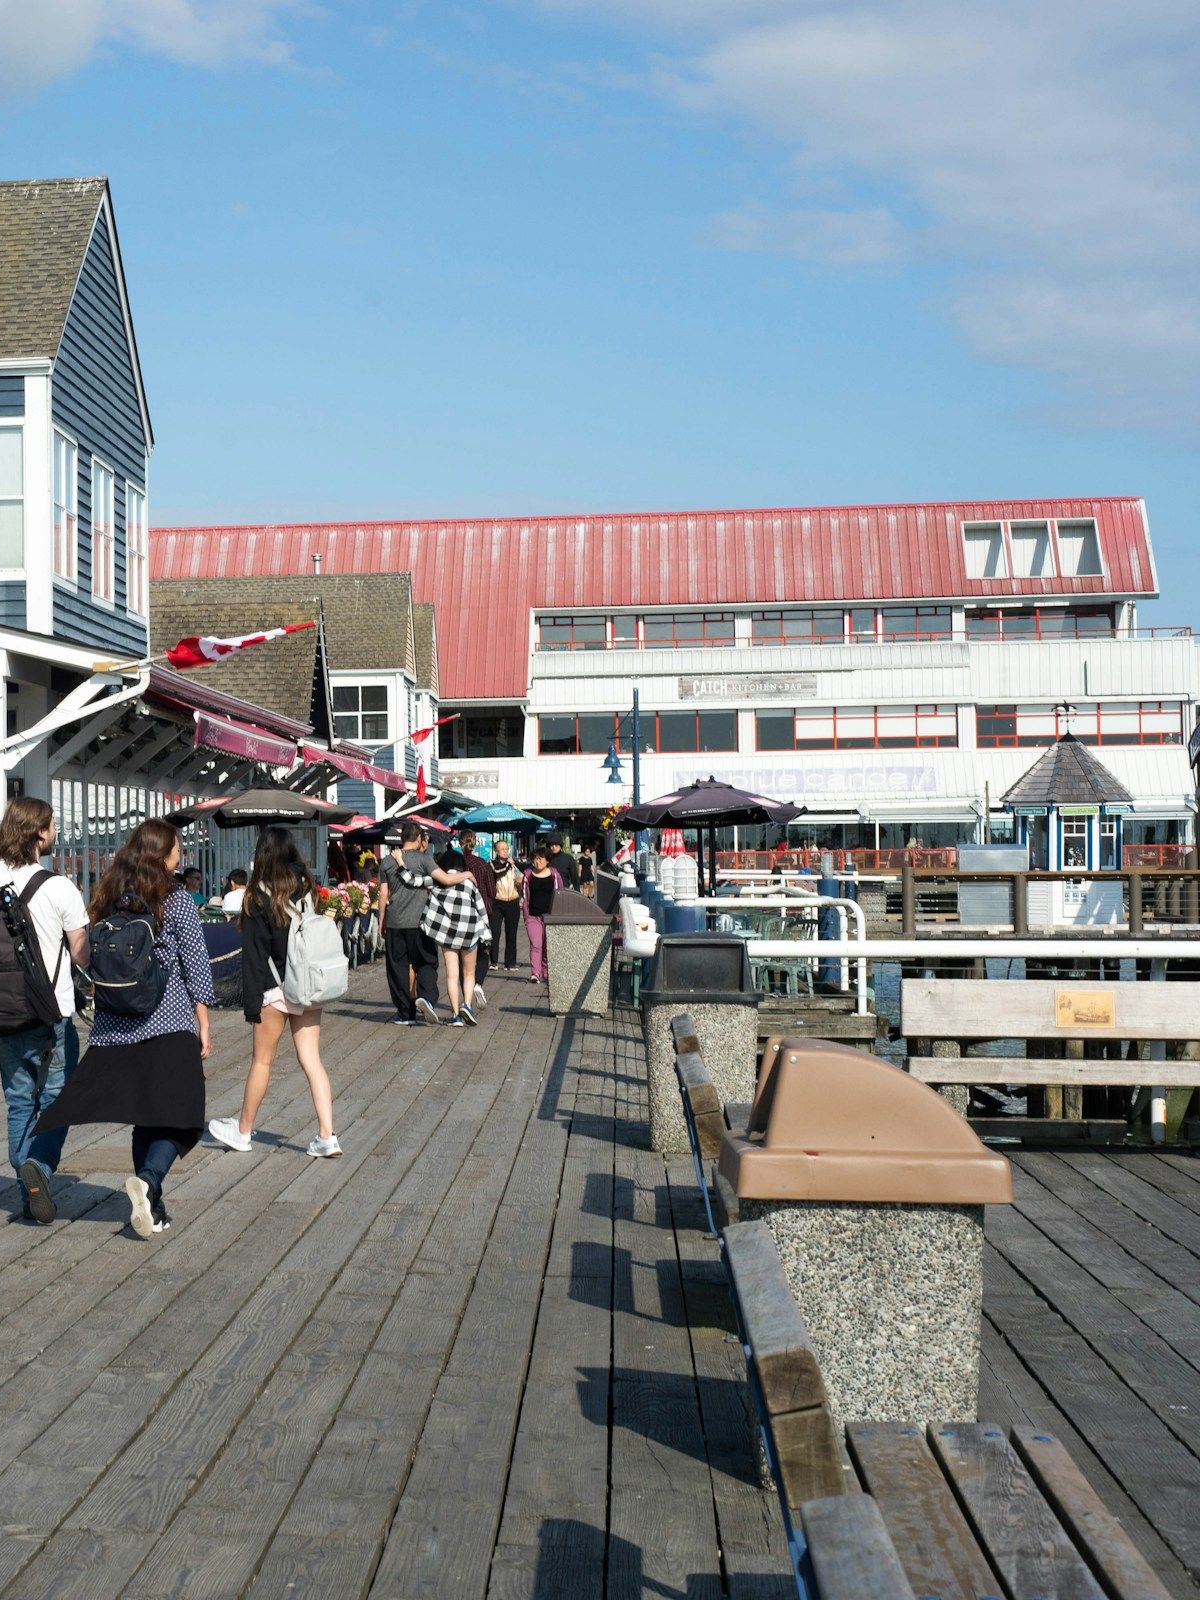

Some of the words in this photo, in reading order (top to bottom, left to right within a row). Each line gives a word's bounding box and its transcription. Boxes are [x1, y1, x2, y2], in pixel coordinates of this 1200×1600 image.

[693, 680, 727, 697] CATCH
[732, 683, 777, 692] KITCHEN
[785, 683, 802, 691] BAR
[468, 776, 499, 784] BAR
[729, 771, 797, 789] blue
[807, 772, 908, 788] canoe
